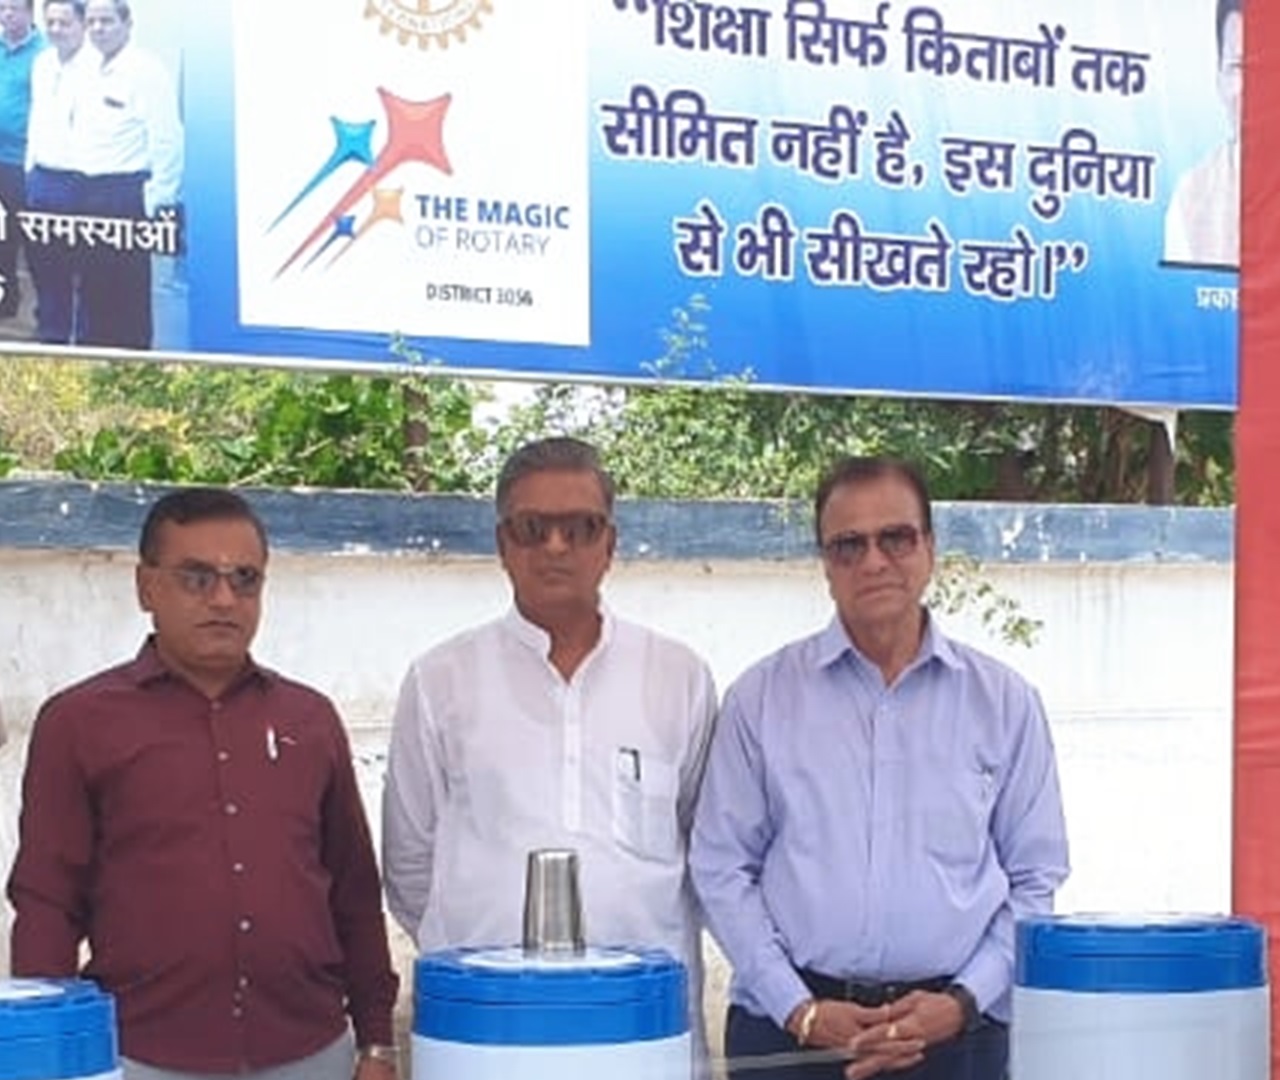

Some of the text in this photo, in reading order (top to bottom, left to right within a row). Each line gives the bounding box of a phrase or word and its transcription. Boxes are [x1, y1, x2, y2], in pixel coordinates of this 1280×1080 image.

[902, 7, 1066, 88] किताबों
[1070, 44, 1151, 96] तक
[600, 85, 758, 166] सीमित
[771, 105, 868, 179] नहीं
[941, 137, 1016, 193] इस
[1027, 128, 1155, 219] दुनिया
[17, 209, 178, 253] समस्याओं
[414, 193, 570, 230] THE MAGIC
[415, 225, 551, 257] OF ROTARY
[677, 205, 724, 273] से
[737, 207, 794, 277] भी
[806, 213, 949, 289] सीखते
[426, 282, 491, 304] DISTRICT
